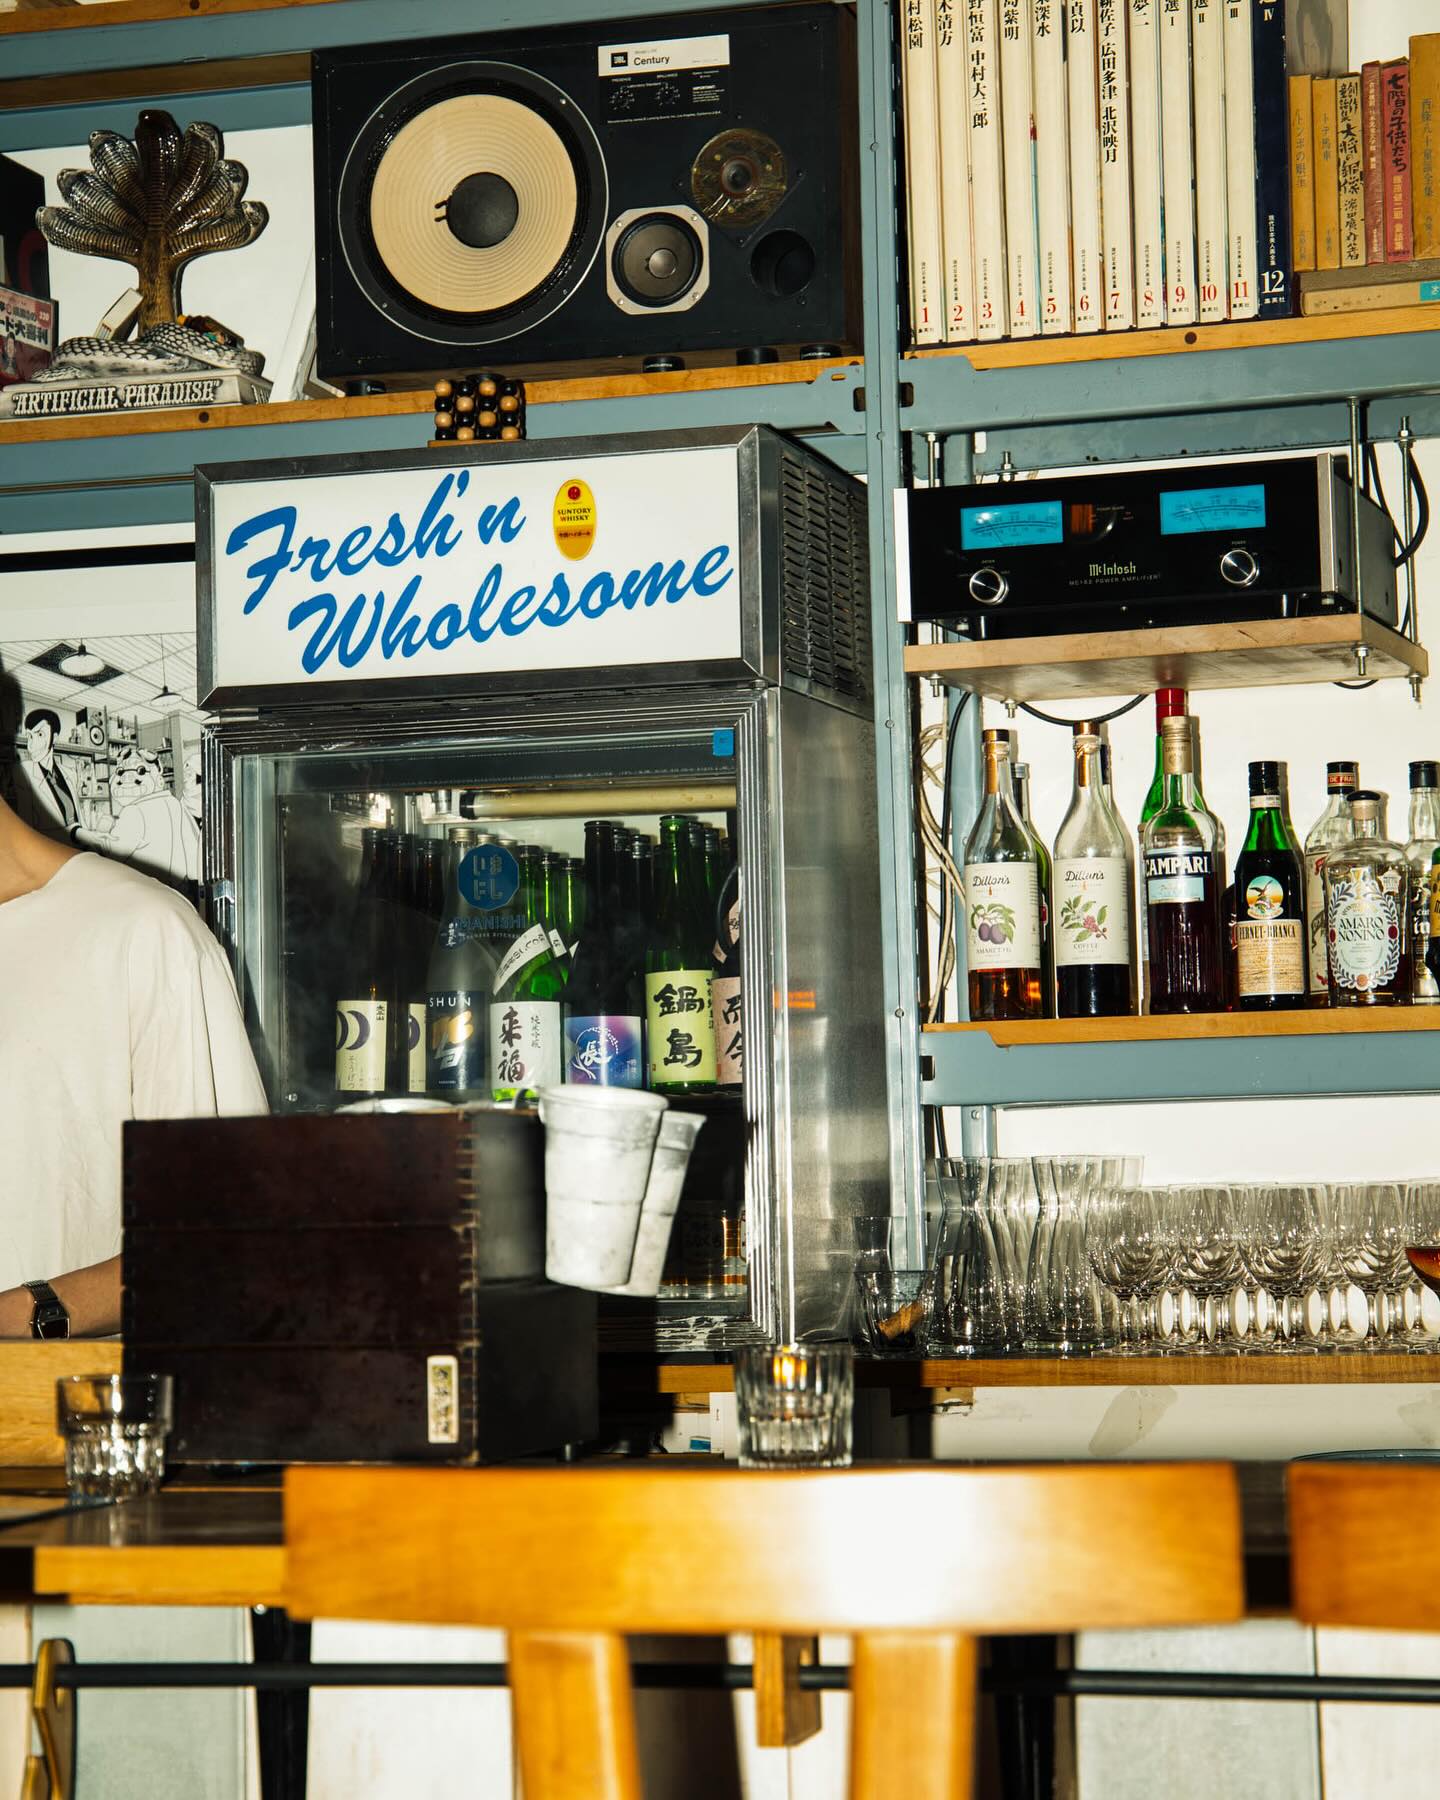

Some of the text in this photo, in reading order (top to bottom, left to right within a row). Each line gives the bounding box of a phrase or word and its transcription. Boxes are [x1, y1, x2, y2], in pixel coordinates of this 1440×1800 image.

[1035, 0, 1051, 37] 深水
[633, 54, 670, 66] Century
[1387, 73, 1408, 173] 七階の子供たち
[1102, 106, 1118, 163] 北沢映月
[1233, 281, 1249, 299] 11
[1260, 270, 1286, 294] 12
[1110, 292, 1120, 310] 7
[1143, 290, 1154, 308] 8
[1175, 286, 1186, 303] 9
[1201, 284, 1217, 302] 10
[982, 302, 993, 319] 3
[1016, 300, 1025, 317] 4
[1047, 297, 1057, 314] 5
[1080, 295, 1090, 312] 6
[922, 306, 929, 323] 1
[953, 305, 963, 321] 2
[557, 507, 592, 515] SUNTORY
[1089, 561, 1137, 576] McIntosh
[288, 544, 734, 674] Wholesome
[972, 874, 1011, 888] Dillon's
[1064, 869, 1105, 883] Dillon's
[1338, 916, 1385, 931] AMARO
[1338, 927, 1385, 943] NONINO
[429, 996, 471, 1008] SHUN
[653, 983, 705, 1069] 鍋島
[497, 1005, 526, 1083] 来福
